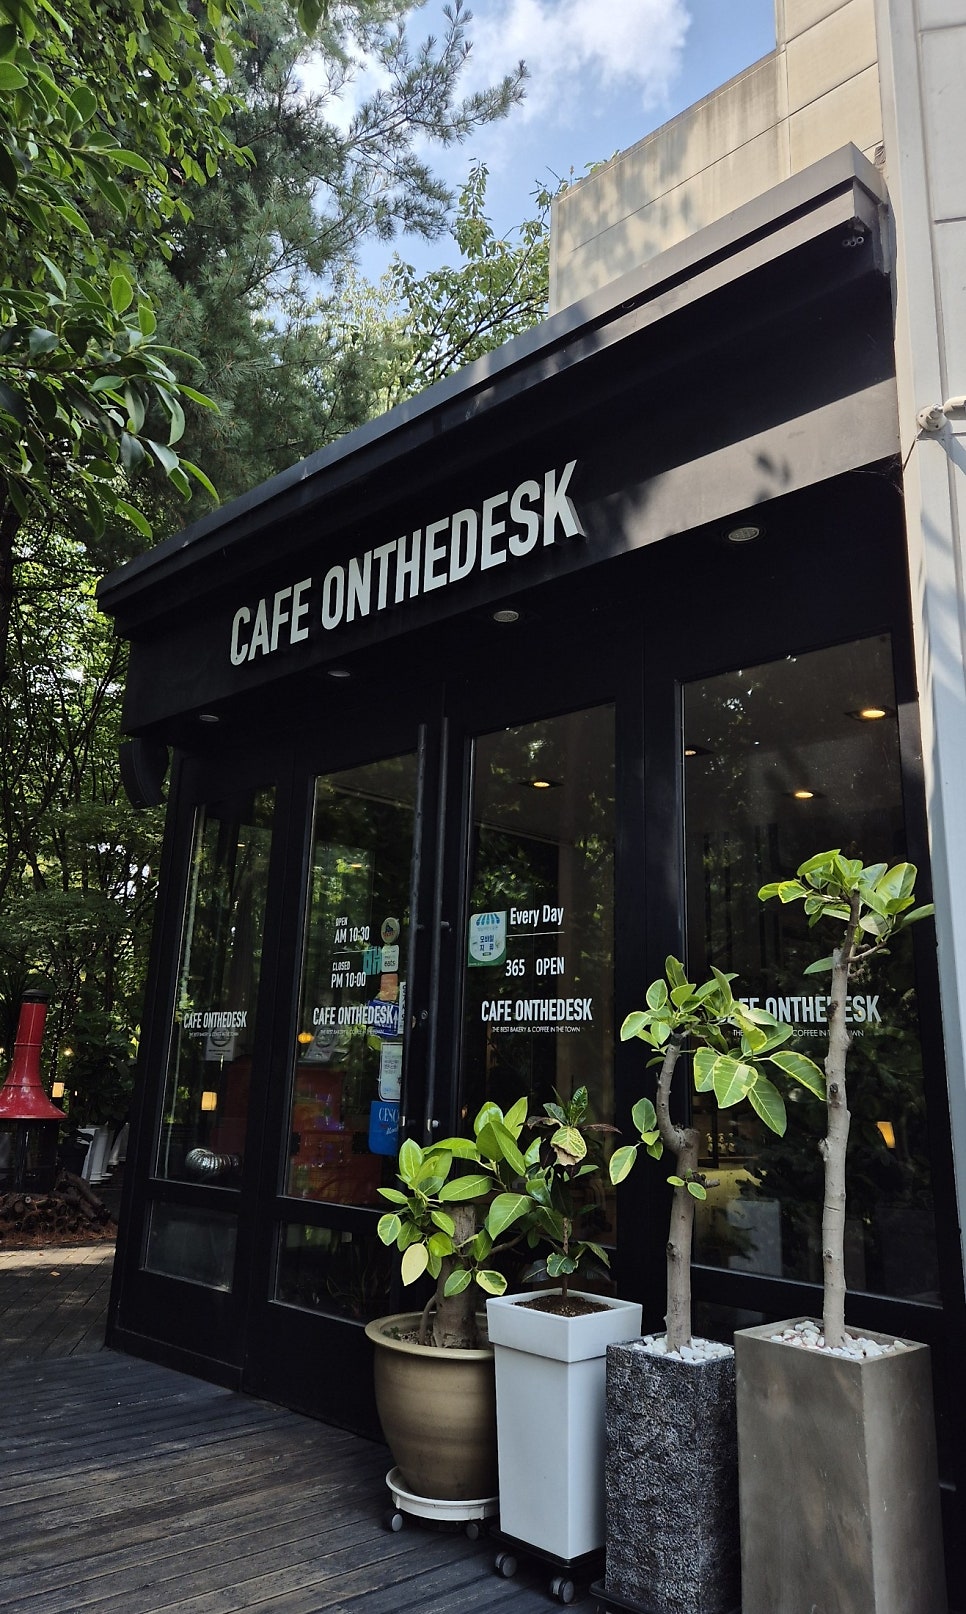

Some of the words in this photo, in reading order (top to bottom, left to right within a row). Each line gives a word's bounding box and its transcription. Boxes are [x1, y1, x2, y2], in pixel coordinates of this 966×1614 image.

[230, 578, 312, 666] CAFE
[321, 459, 583, 630] ONTHEDESK
[335, 917, 348, 927] OPEN
[510, 907, 540, 927] Every
[542, 905, 564, 926] Day
[334, 928, 347, 943] AM
[349, 926, 370, 942] 10:30
[332, 961, 351, 971] CLOSED
[505, 958, 525, 977] 365
[536, 957, 565, 976] OPEN
[331, 973, 343, 988] PM
[345, 972, 367, 988] 10:00
[313, 1007, 336, 1025] CAFE
[338, 1005, 394, 1025] ONTHEDESK
[481, 1000, 512, 1022] CAFE
[515, 998, 593, 1021] ONTHEDESK
[765, 995, 882, 1023] ONTHEESK
[183, 1012, 202, 1028] CAFE
[203, 1011, 248, 1028] ONTHEDESK
[792, 1029, 818, 1037] COFFEE
[819, 1029, 827, 1037] IN
